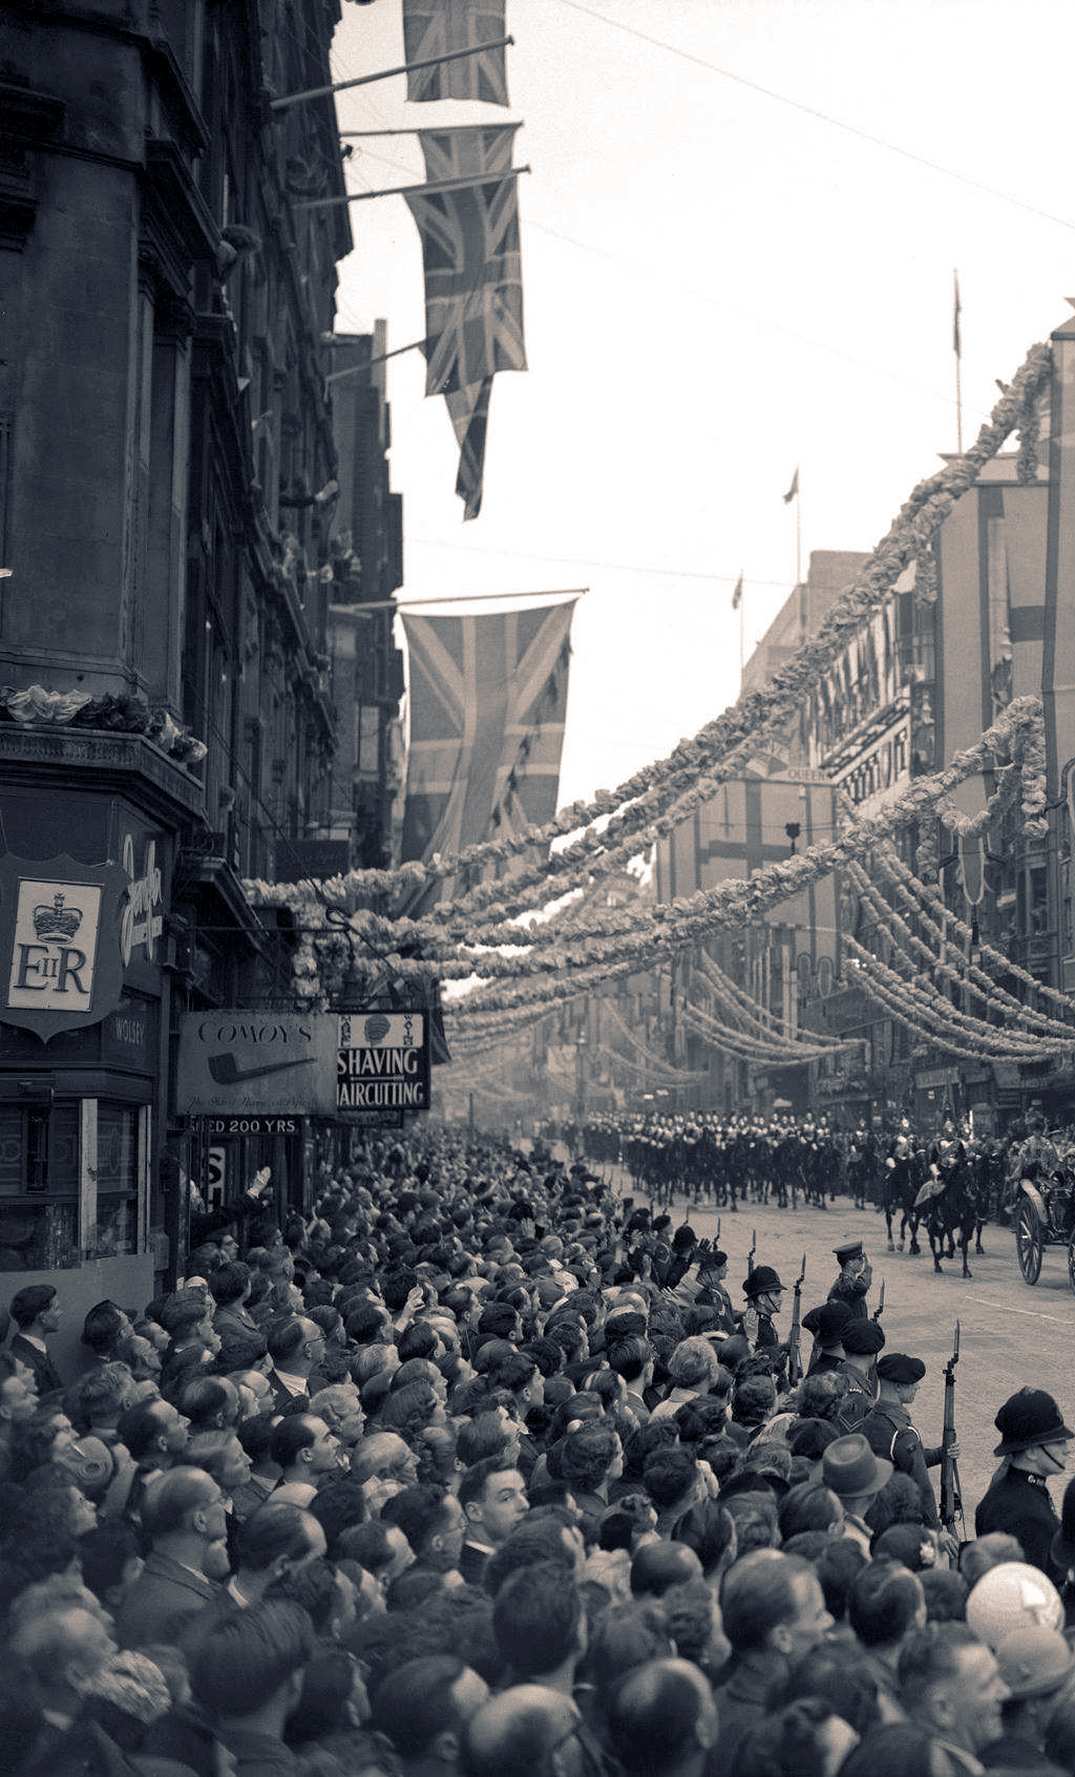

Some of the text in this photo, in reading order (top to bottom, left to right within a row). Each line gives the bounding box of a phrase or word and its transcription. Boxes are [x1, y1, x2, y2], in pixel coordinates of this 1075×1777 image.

[337, 1049, 419, 1075] SHAVING
[337, 1082, 424, 1106] AIRCUTTING
[230, 1119, 260, 1133] 200
[265, 1119, 296, 1133] YRS
